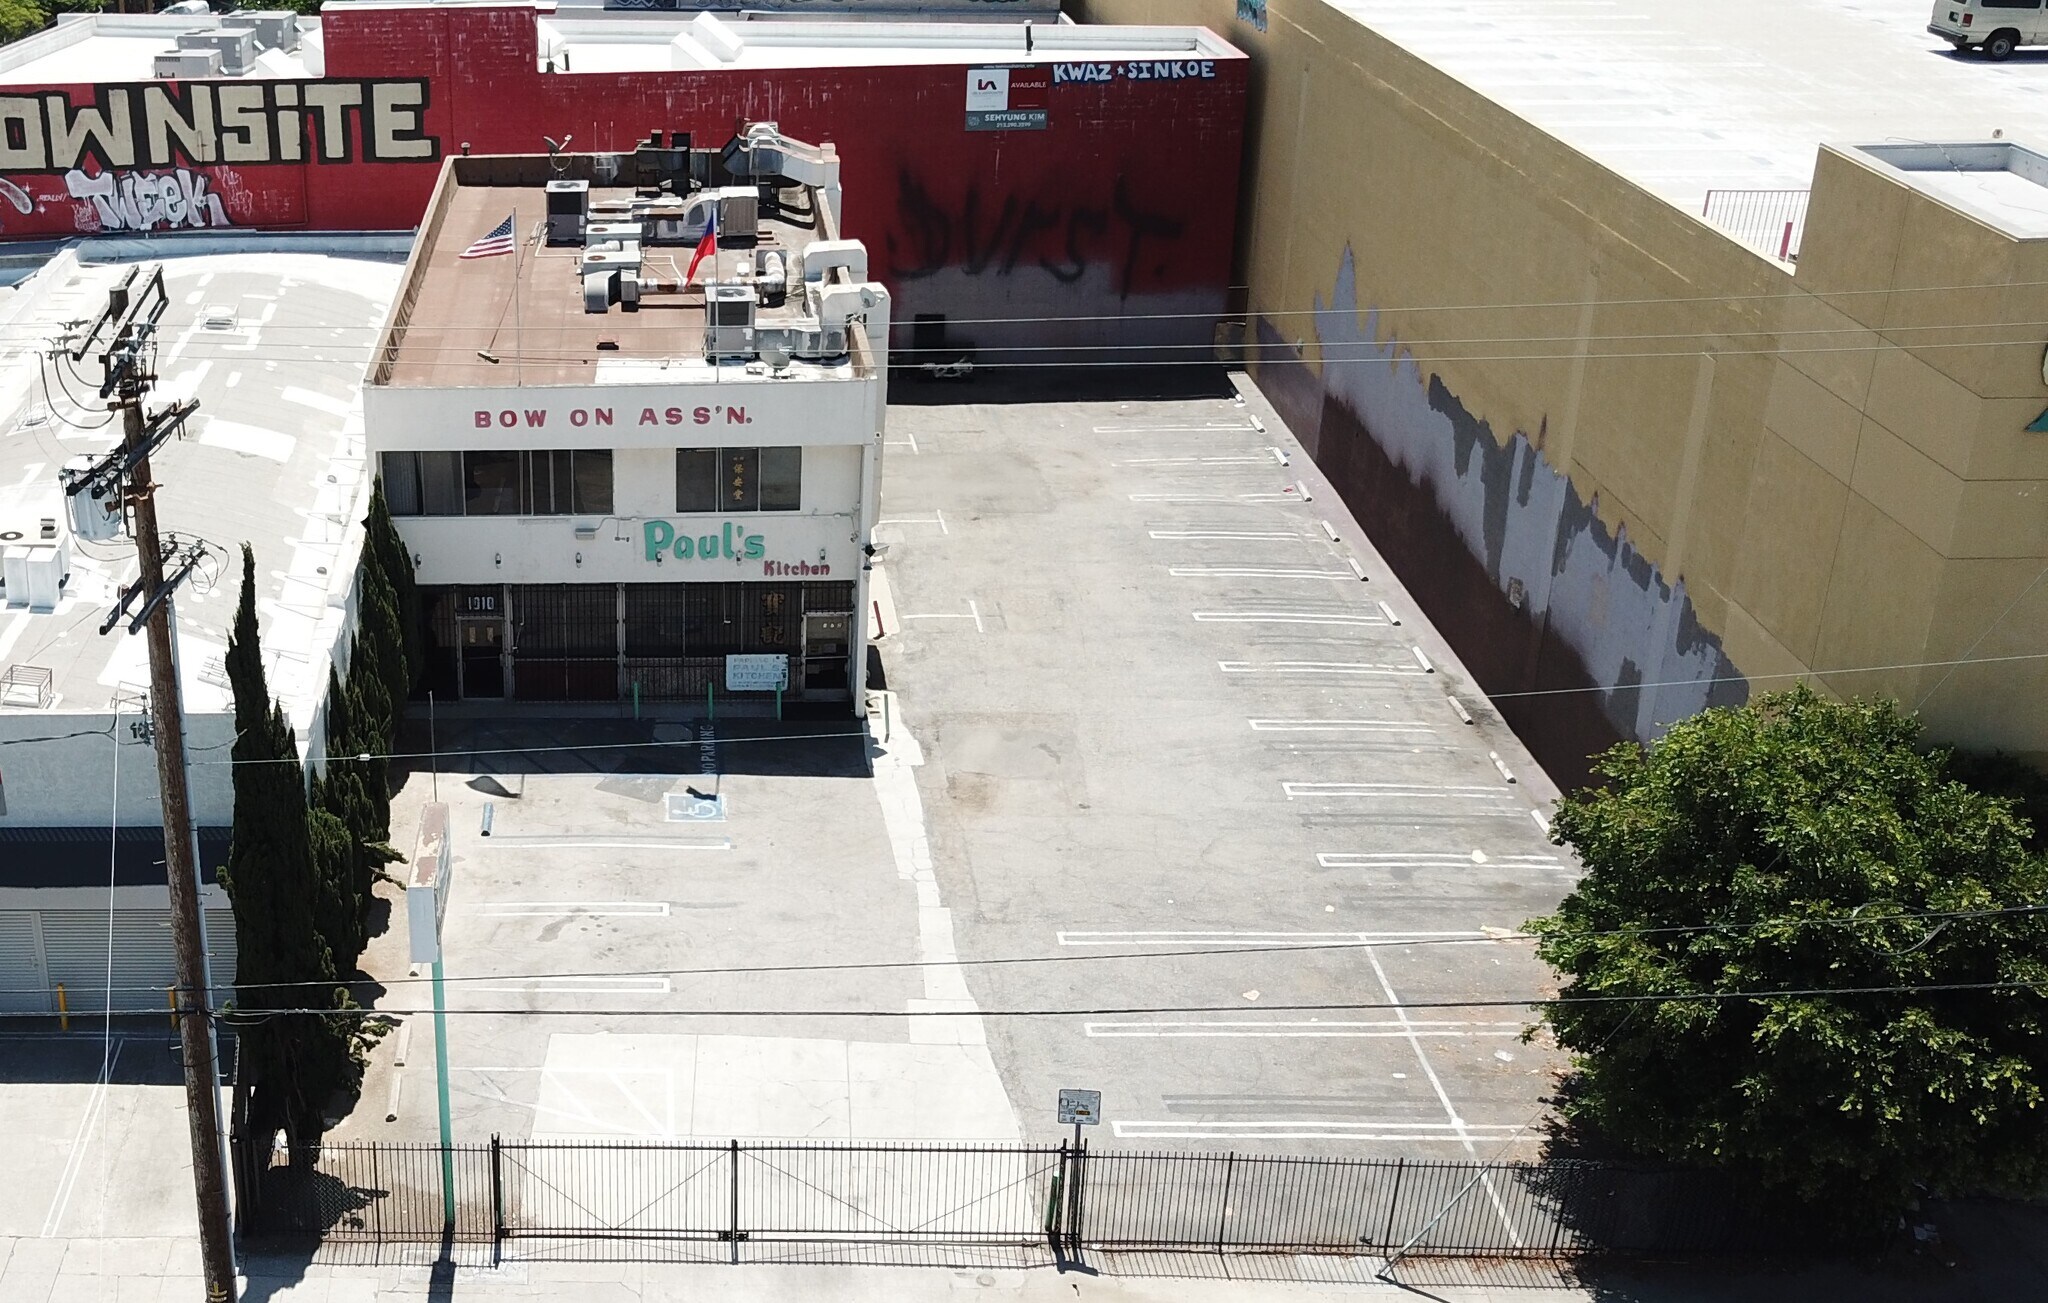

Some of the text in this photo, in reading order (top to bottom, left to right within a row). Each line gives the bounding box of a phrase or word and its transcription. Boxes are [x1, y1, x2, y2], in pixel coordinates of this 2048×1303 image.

[1052, 61, 1216, 83] KWAZ SINKOE
[474, 406, 754, 428] BOW ON ASS'N.
[643, 520, 765, 562] Paul's
[763, 560, 830, 576] Kitchen
